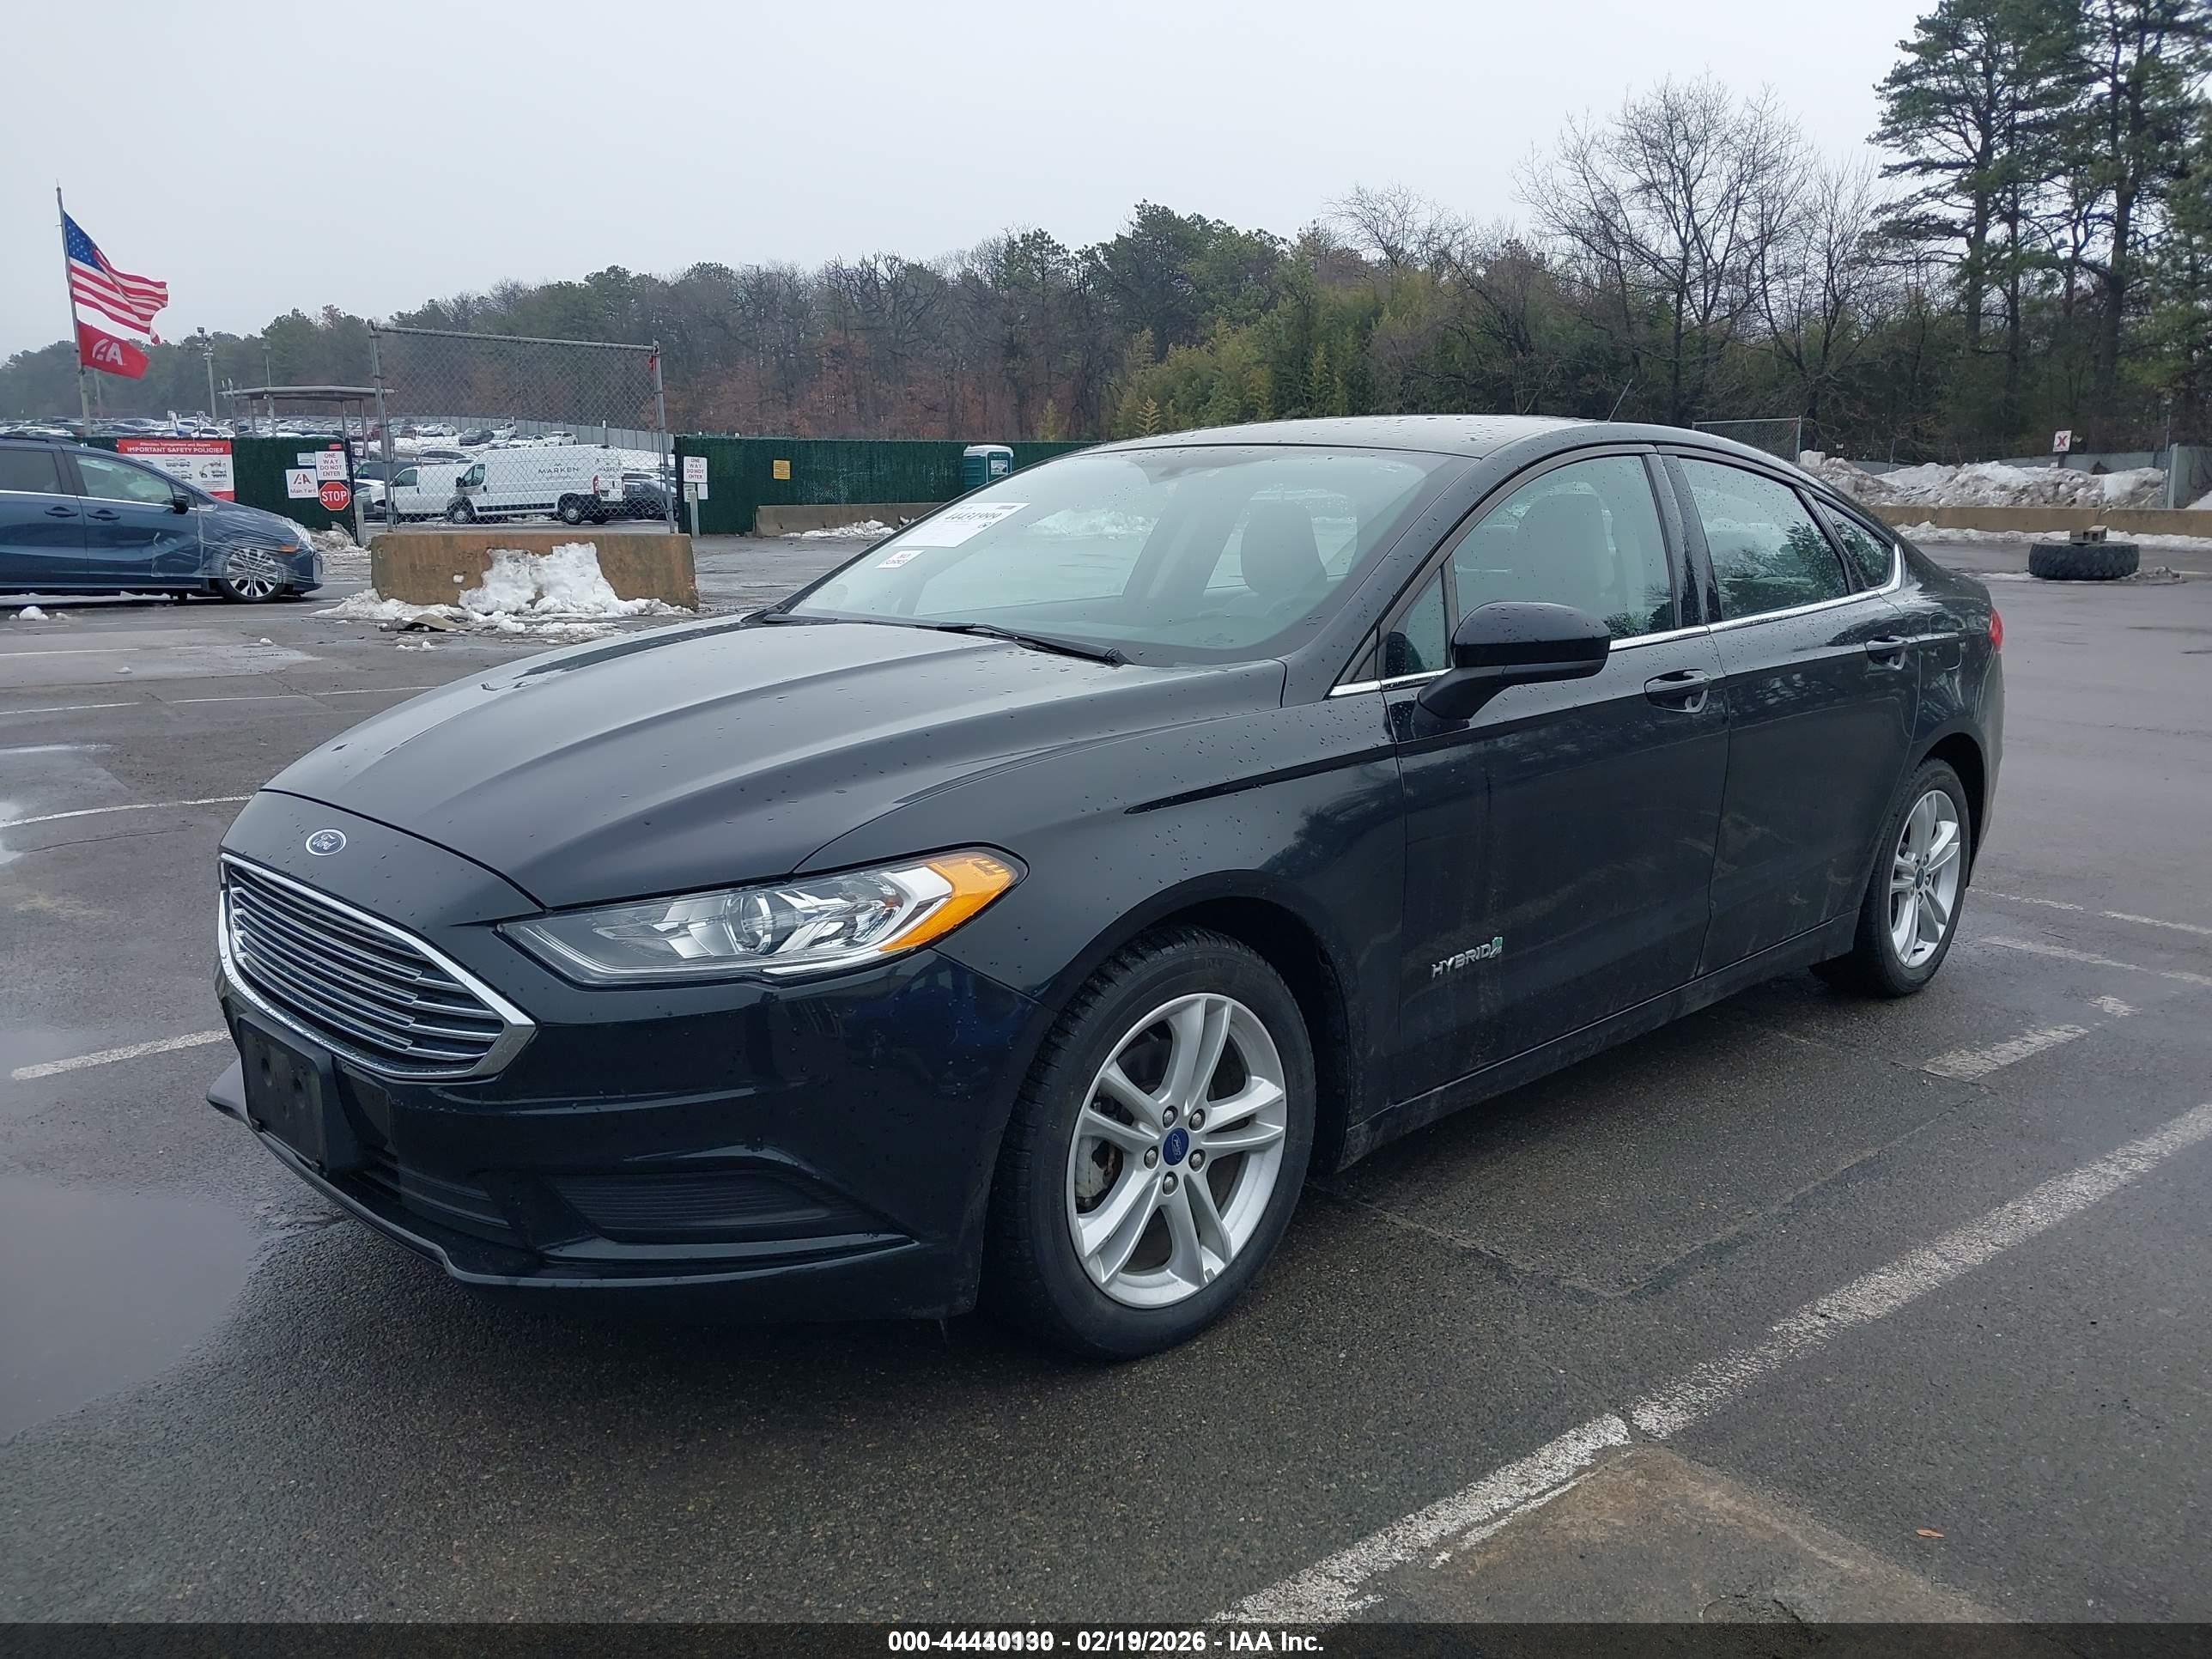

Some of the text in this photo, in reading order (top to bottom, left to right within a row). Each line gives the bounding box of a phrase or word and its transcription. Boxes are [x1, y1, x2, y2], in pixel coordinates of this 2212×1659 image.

[538, 466, 580, 475] MARKEN
[321, 490, 347, 502] STOP
[312, 833, 337, 851] Ford
[1431, 943, 1492, 979] HYBRID
